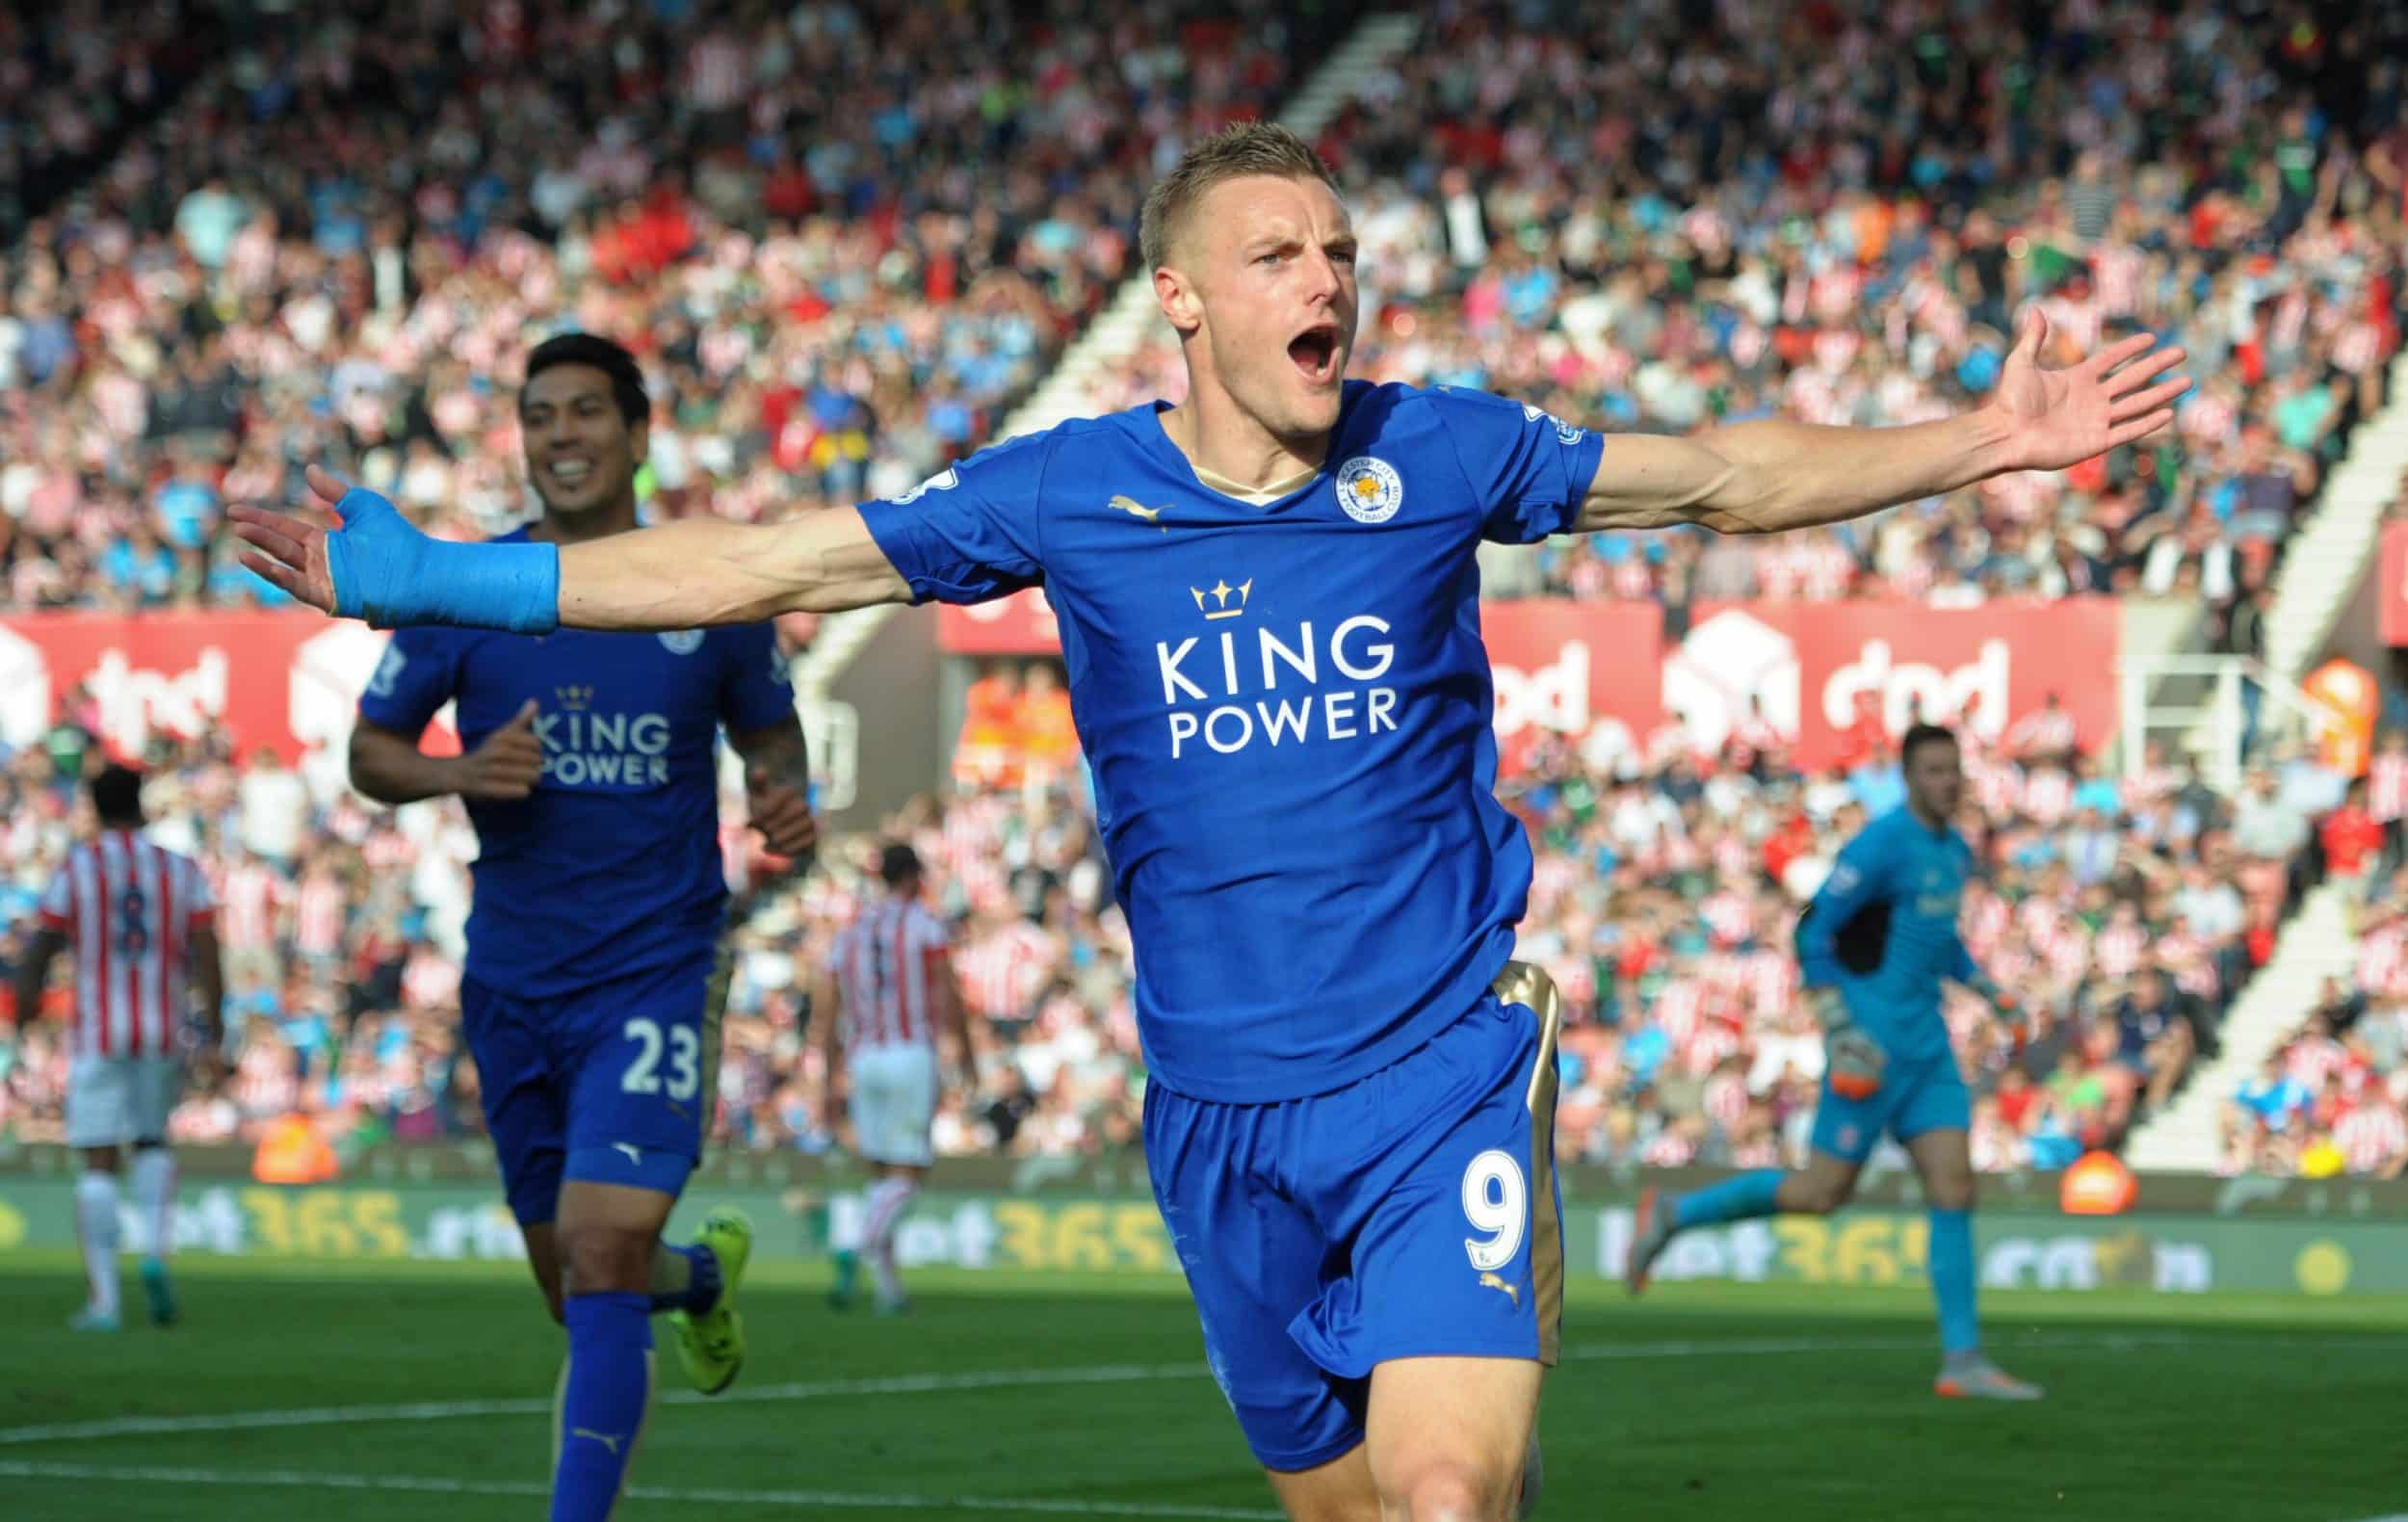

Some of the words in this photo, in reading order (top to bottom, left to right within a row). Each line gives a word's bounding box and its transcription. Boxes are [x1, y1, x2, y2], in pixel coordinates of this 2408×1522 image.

[1156, 615, 1395, 705] KING
[1491, 640, 1589, 735] pd
[533, 713, 670, 754] KING
[1167, 687, 1399, 759] POWER
[621, 1016, 699, 1102] 23
[1461, 1149, 1527, 1272] 9
